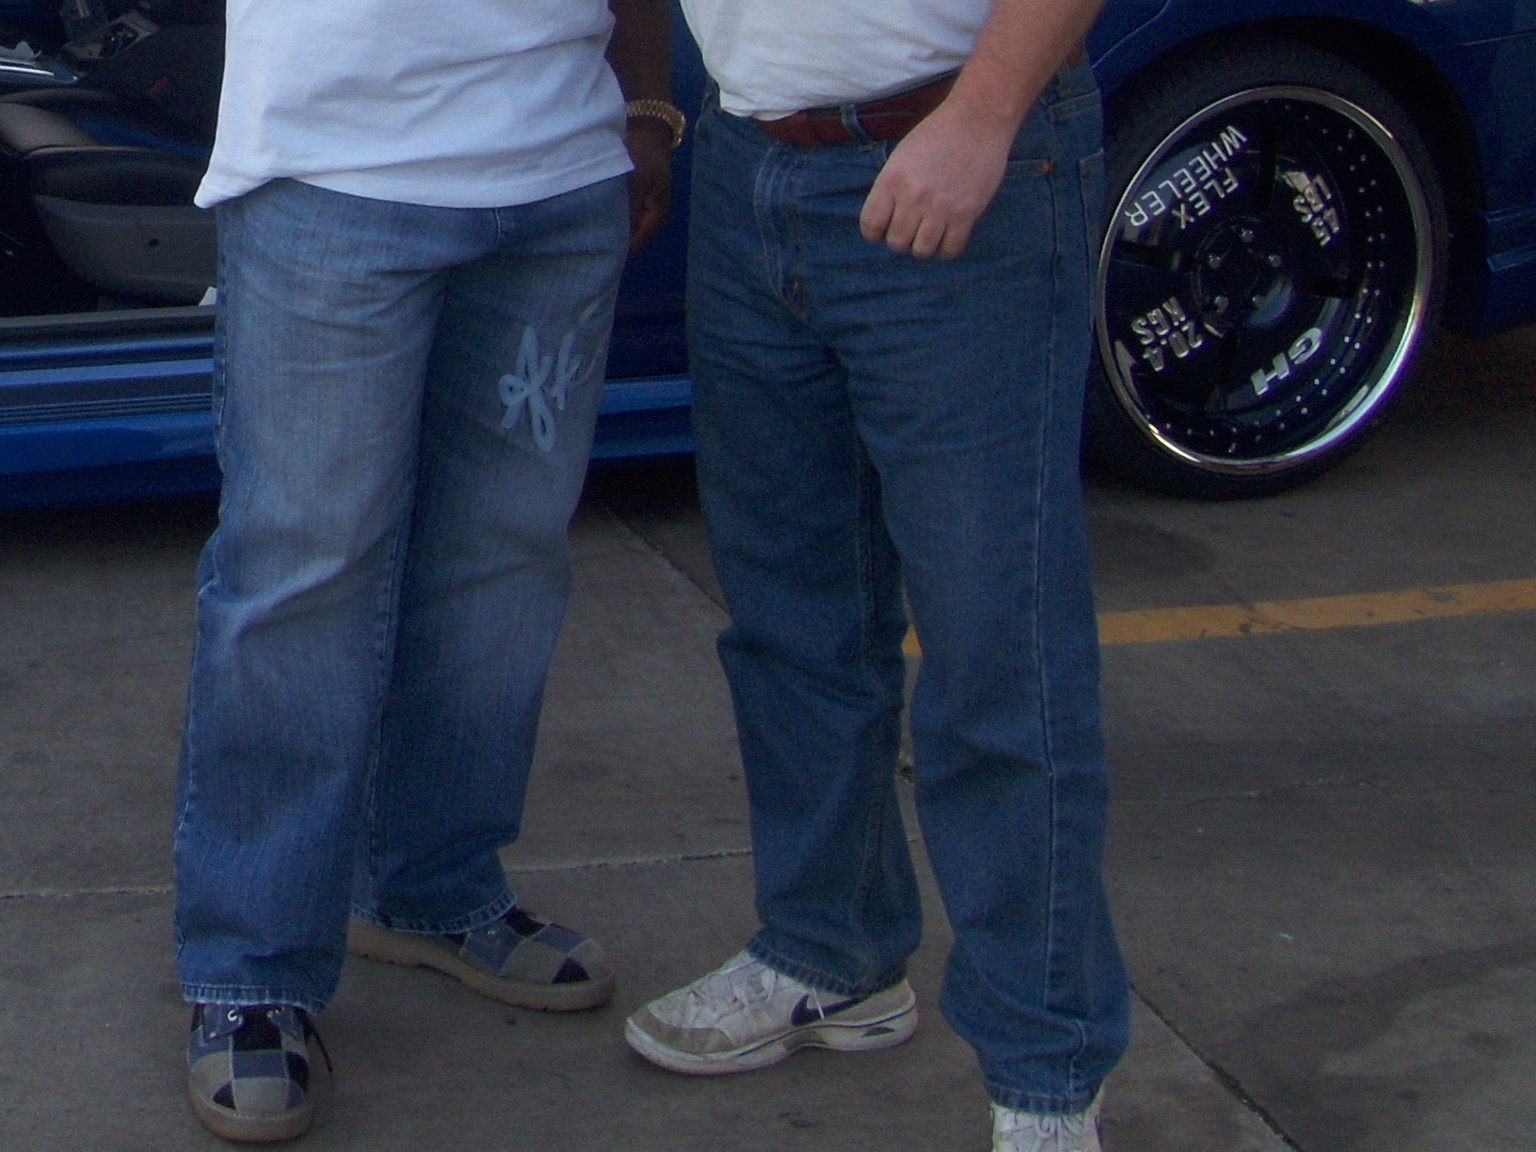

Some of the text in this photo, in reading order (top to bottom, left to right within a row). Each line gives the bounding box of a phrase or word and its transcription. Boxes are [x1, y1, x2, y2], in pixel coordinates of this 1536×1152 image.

[1124, 125, 1247, 227] WHEELER
[1172, 167, 1239, 230] FLEX
[1130, 296, 1186, 346] KGS
[1250, 327, 1322, 396] GH
